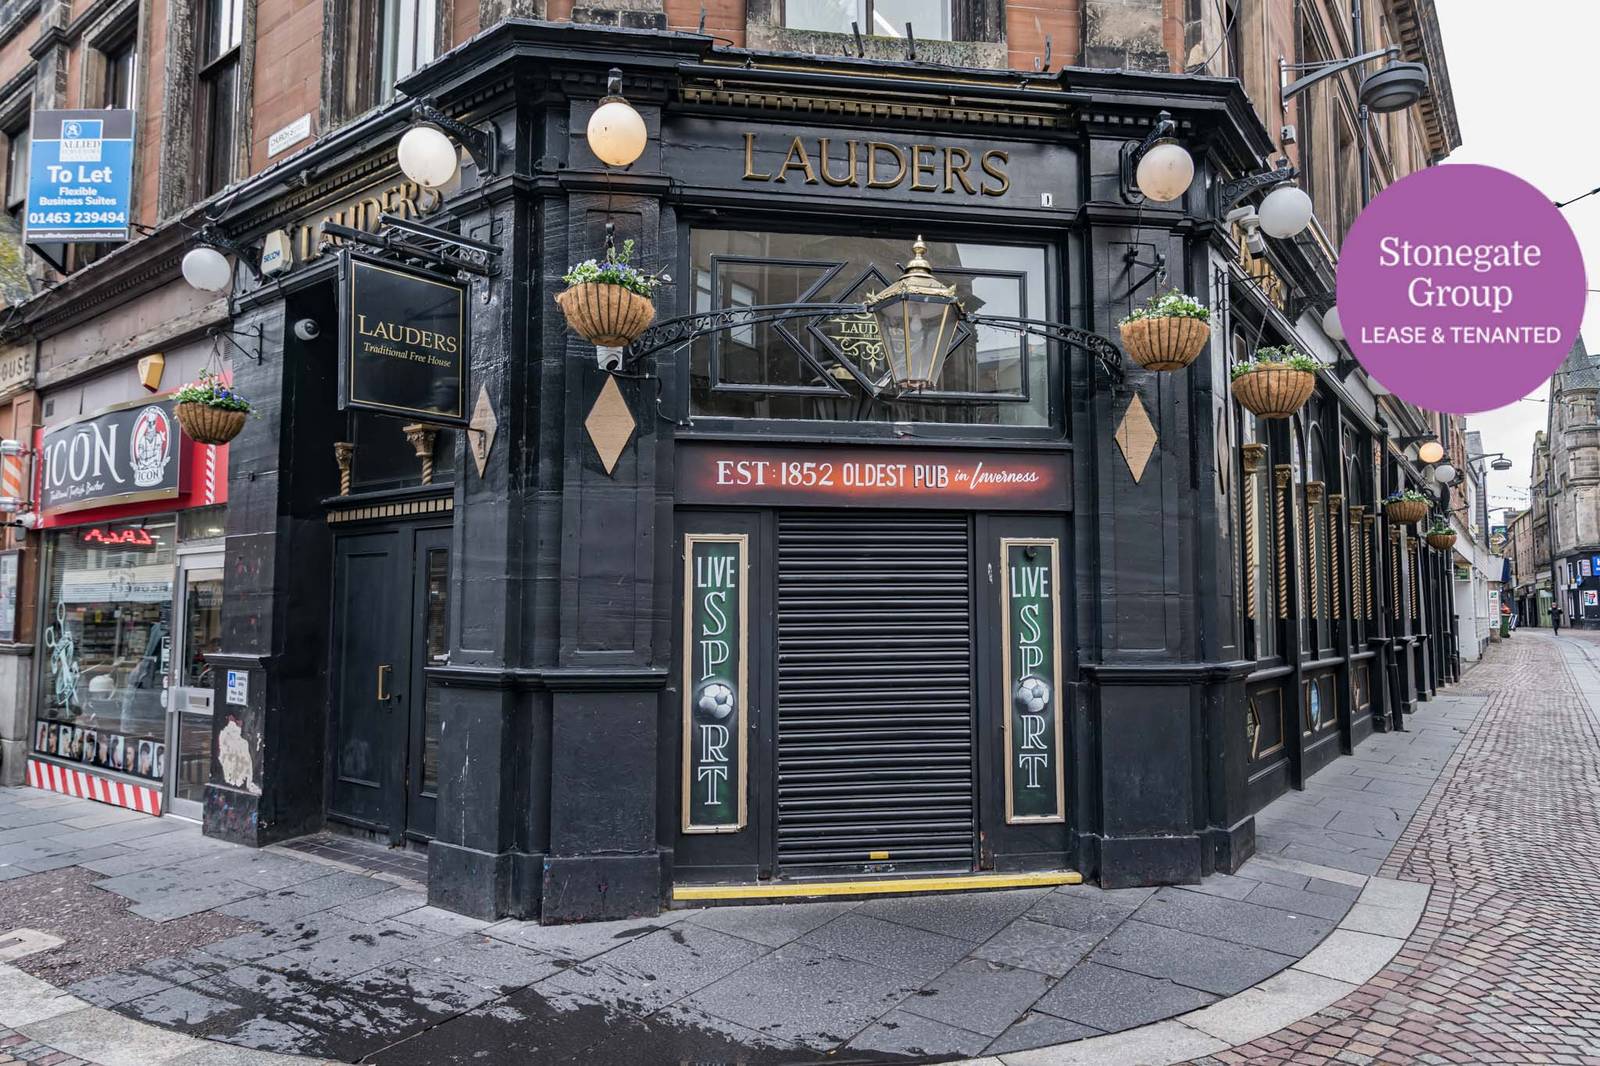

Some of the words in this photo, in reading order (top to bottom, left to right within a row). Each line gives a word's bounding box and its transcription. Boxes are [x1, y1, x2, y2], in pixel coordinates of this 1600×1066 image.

[47, 165, 73, 183] To
[78, 165, 113, 183] Let
[742, 132, 1010, 197] LAUDERS
[39, 197, 83, 206] Business
[85, 197, 117, 206] Suites
[59, 187, 97, 196] Flexible
[29, 213, 71, 224] 01463
[74, 212, 126, 224] 239494
[358, 314, 457, 353] LAUDERS
[840, 322, 879, 334] LAUD
[363, 342, 408, 360] Traditional
[409, 351, 426, 363] Free
[427, 355, 452, 367] House
[44, 422, 126, 490] ICON
[138, 469, 159, 480] ICON
[781, 462, 834, 486] 1852
[842, 462, 907, 487] OLDEST
[913, 464, 949, 488] PUB
[954, 469, 969, 482] in
[969, 462, 1039, 490] Inverness
[697, 556, 735, 588] LIVE
[1011, 566, 1049, 598] LIVE
